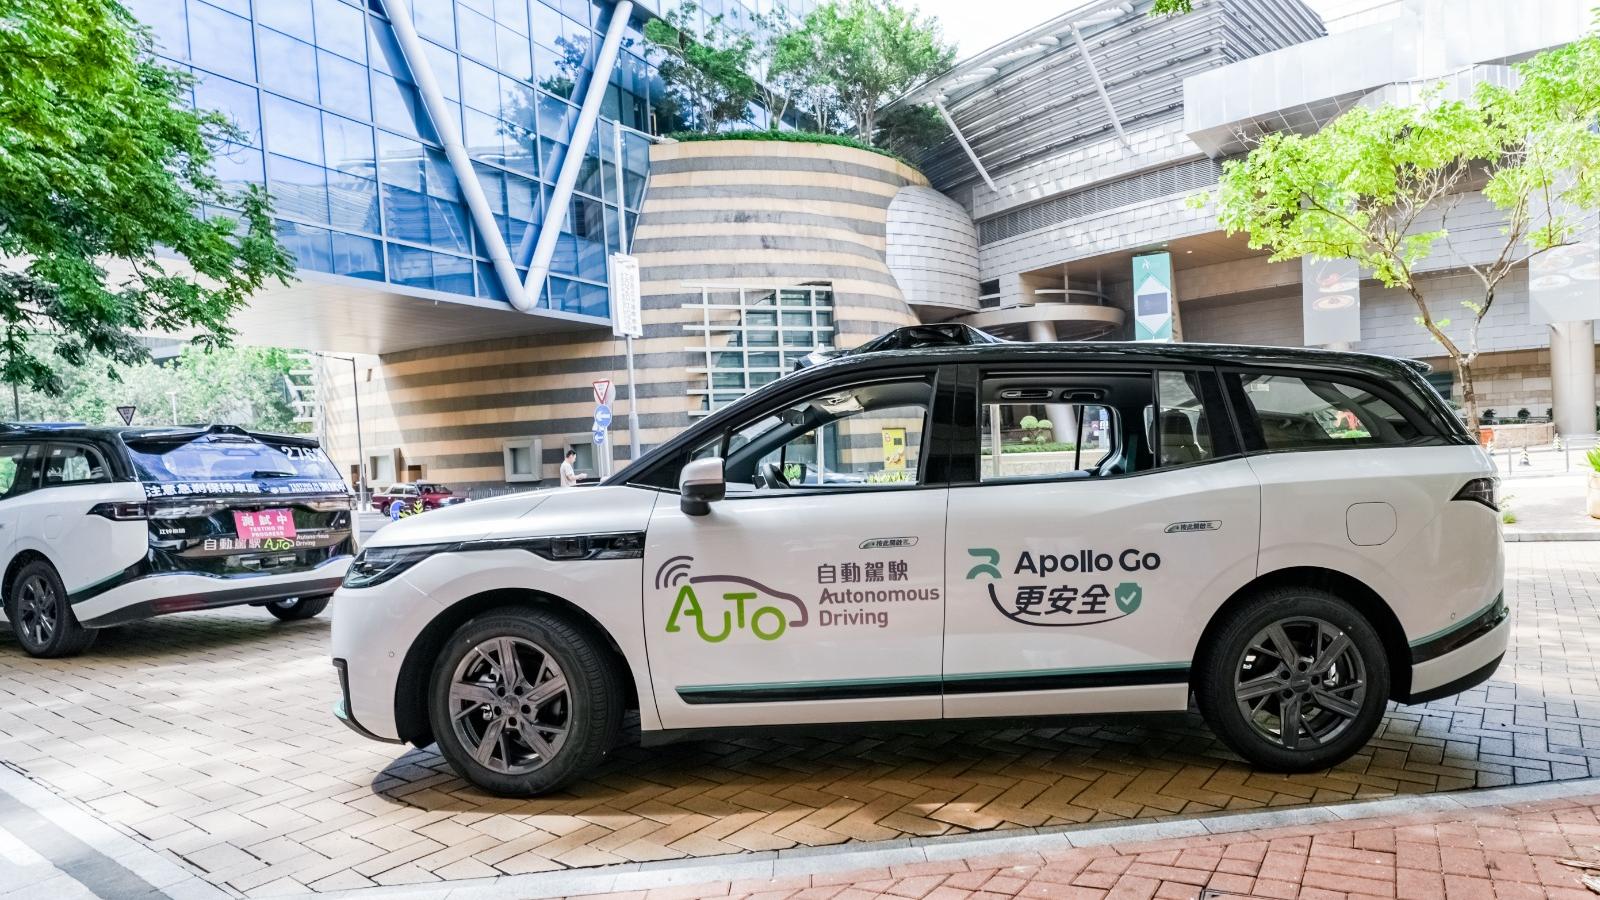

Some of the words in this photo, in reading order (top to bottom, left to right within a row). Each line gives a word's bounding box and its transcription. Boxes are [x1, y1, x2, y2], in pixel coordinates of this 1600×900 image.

[817, 559, 909, 584] 自動駕駛
[1013, 549, 1113, 578] Apollo
[1118, 548, 1161, 572] Go
[818, 587, 940, 605] Autonomous
[1011, 583, 1111, 617] 更安全
[818, 608, 889, 628] Driving
